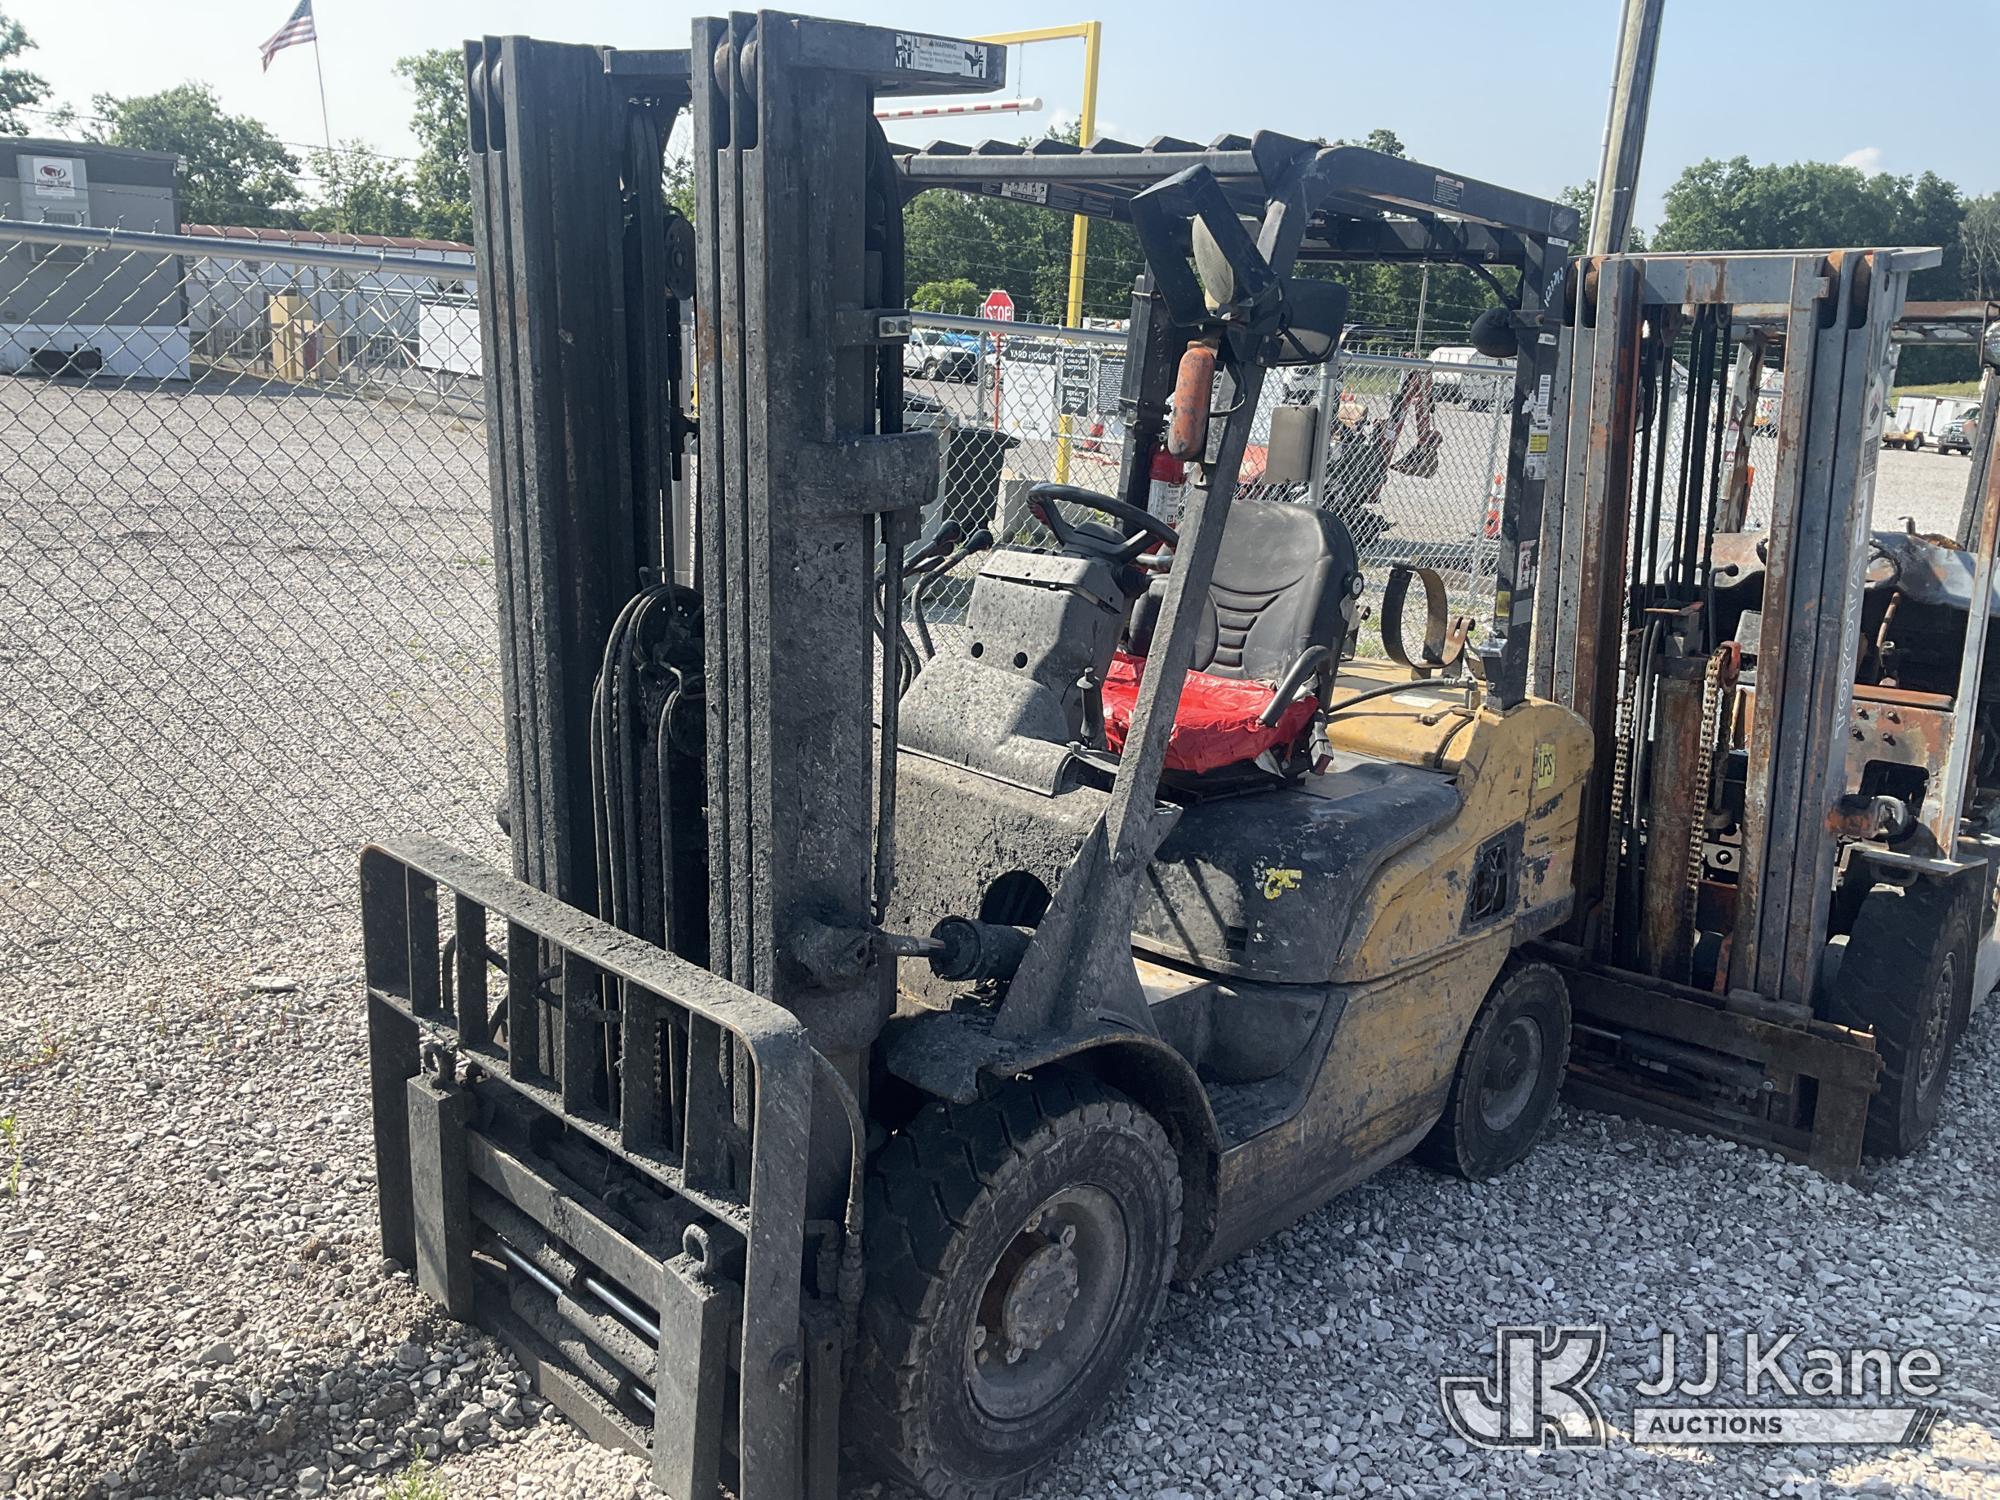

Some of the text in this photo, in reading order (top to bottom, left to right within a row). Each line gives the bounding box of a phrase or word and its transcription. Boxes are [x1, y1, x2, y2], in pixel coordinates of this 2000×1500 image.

[986, 305, 1011, 321] STOP
[1009, 350, 1028, 359] YARD
[1834, 556, 1863, 740] TOYOTA
